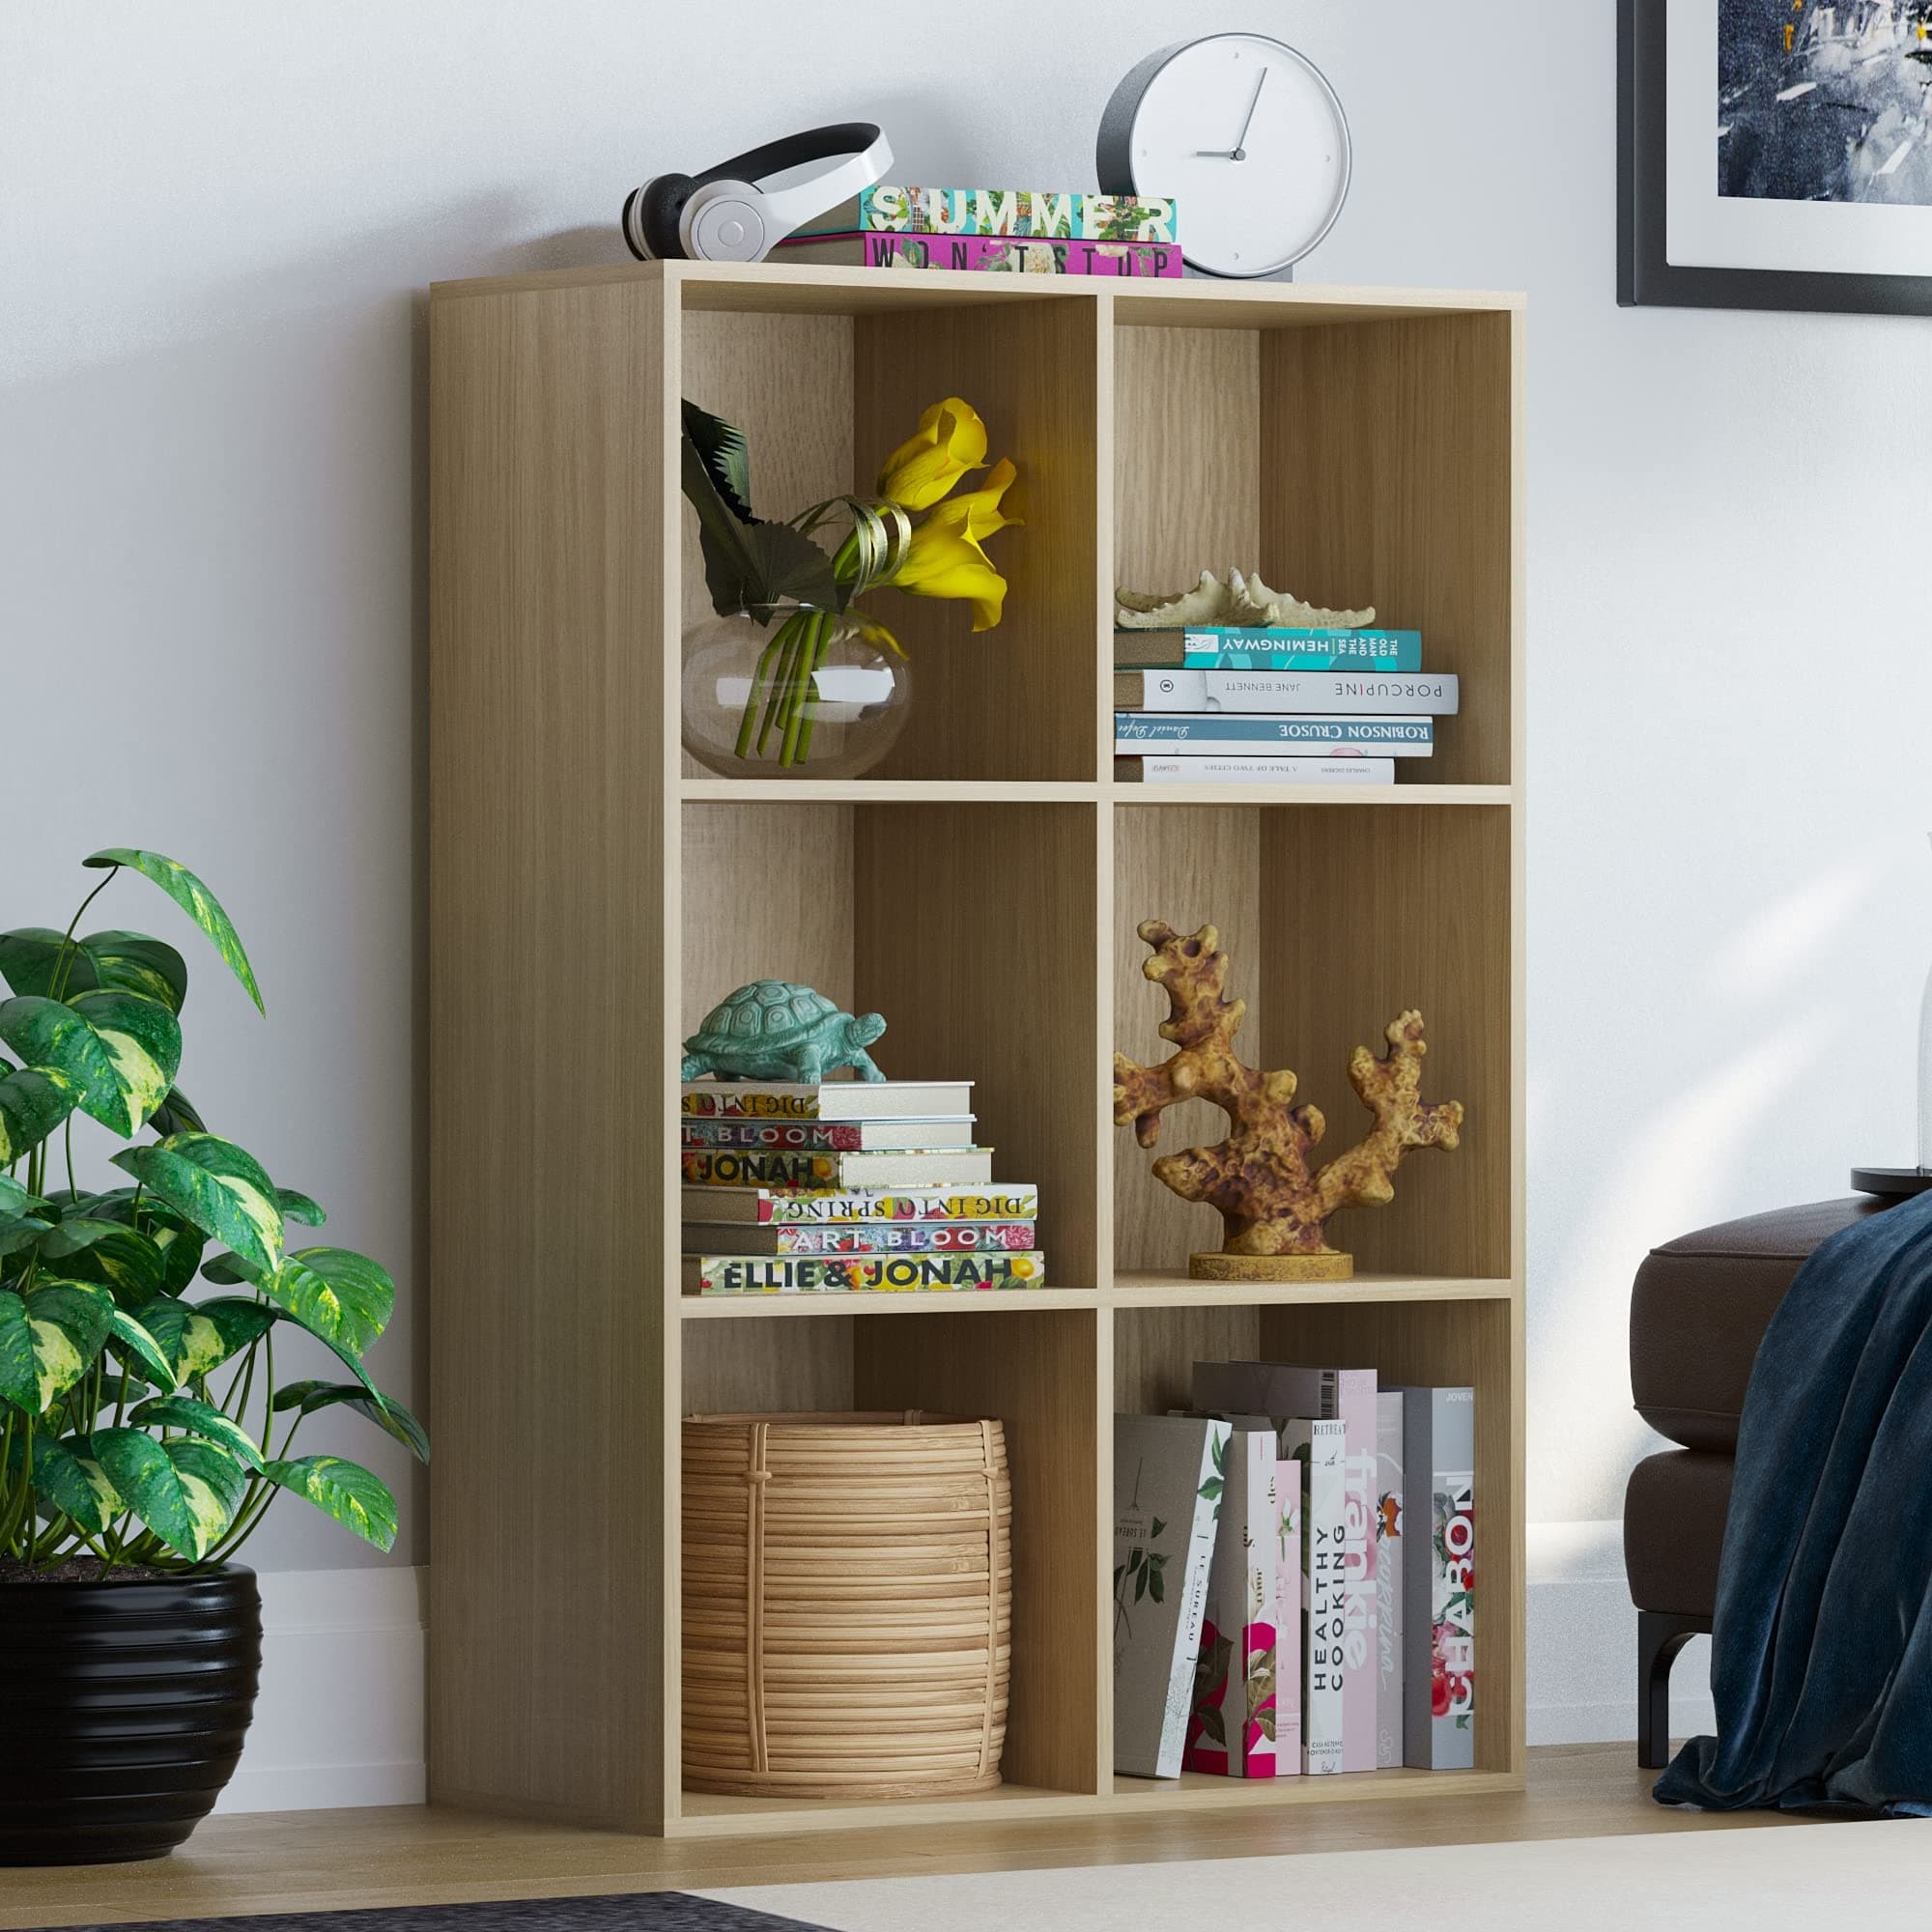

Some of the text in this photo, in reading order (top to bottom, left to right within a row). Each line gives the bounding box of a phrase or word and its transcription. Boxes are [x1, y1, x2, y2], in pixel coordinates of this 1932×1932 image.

[871, 186, 1174, 242] SUMMER
[1056, 243, 1168, 278] STOP
[1223, 637, 1329, 653] HEMINGWAY
[1338, 638, 1347, 654] SEA
[1349, 638, 1357, 655] THE
[1359, 638, 1368, 657] AND
[1369, 638, 1378, 657] MAN
[1378, 639, 1387, 657] OLD
[1389, 639, 1398, 657] THE
[1225, 681, 1301, 693] JANE BENNETT
[1335, 682, 1442, 697] PORCUPINE
[1149, 725, 1190, 739] Daniel
[1280, 724, 1429, 740] ROBINSON CRUSOE
[699, 1096, 758, 1114] INTO
[765, 1097, 806, 1114] DIG
[718, 1127, 834, 1145] BLOOM
[699, 1154, 813, 1181] JONAH
[786, 1197, 1021, 1219] DIG INTO SPRING
[793, 1229, 1009, 1249] ART BLOOM
[724, 1258, 1011, 1288] ELLIE & JONAH
[1345, 1448, 1377, 1670] frankie
[1445, 1476, 1475, 1713] CHABON
[1314, 1527, 1328, 1690] HEALTHY
[1331, 1525, 1345, 1691] COOKING
